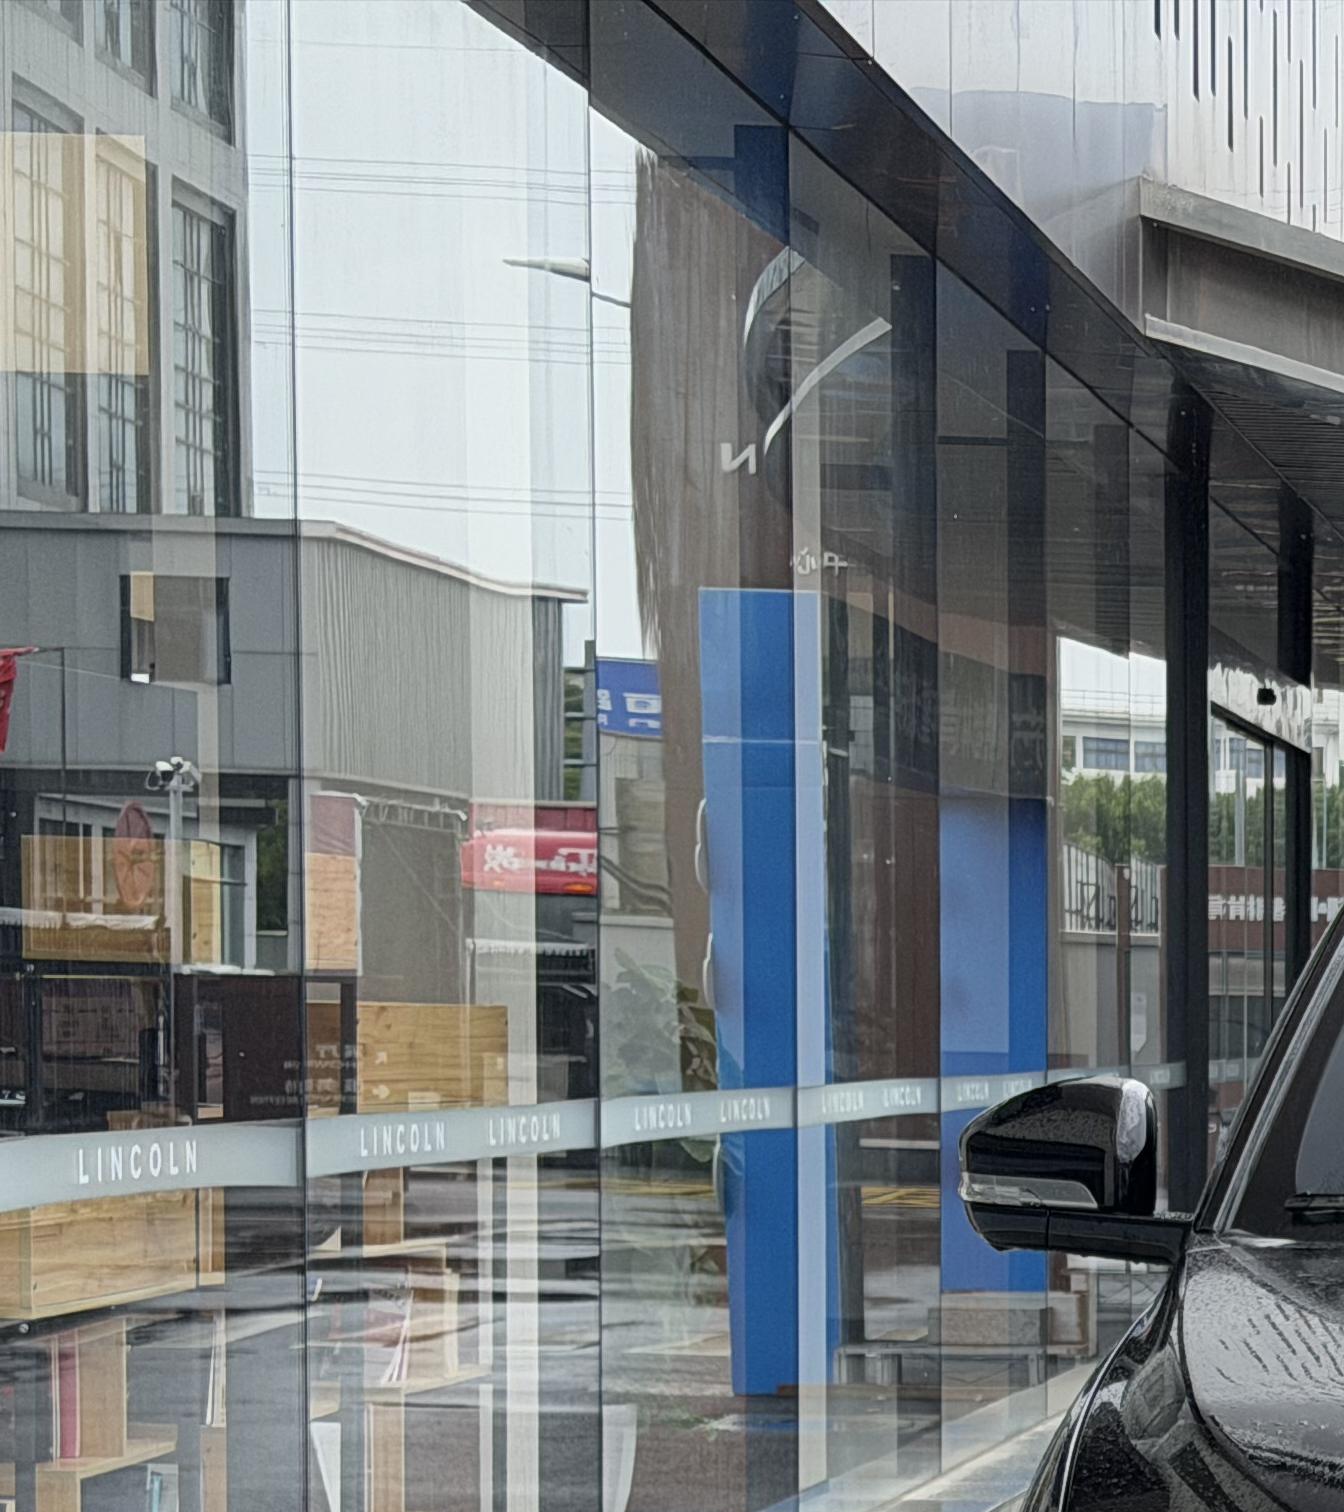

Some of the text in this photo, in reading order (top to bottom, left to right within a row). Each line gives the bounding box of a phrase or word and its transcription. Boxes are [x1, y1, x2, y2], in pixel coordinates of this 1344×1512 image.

[360, 1112, 561, 1157] LINCOLN LINCOLN
[634, 1096, 771, 1131] LINCOLN LINCOLN
[77, 1138, 199, 1185] LINCOLN
